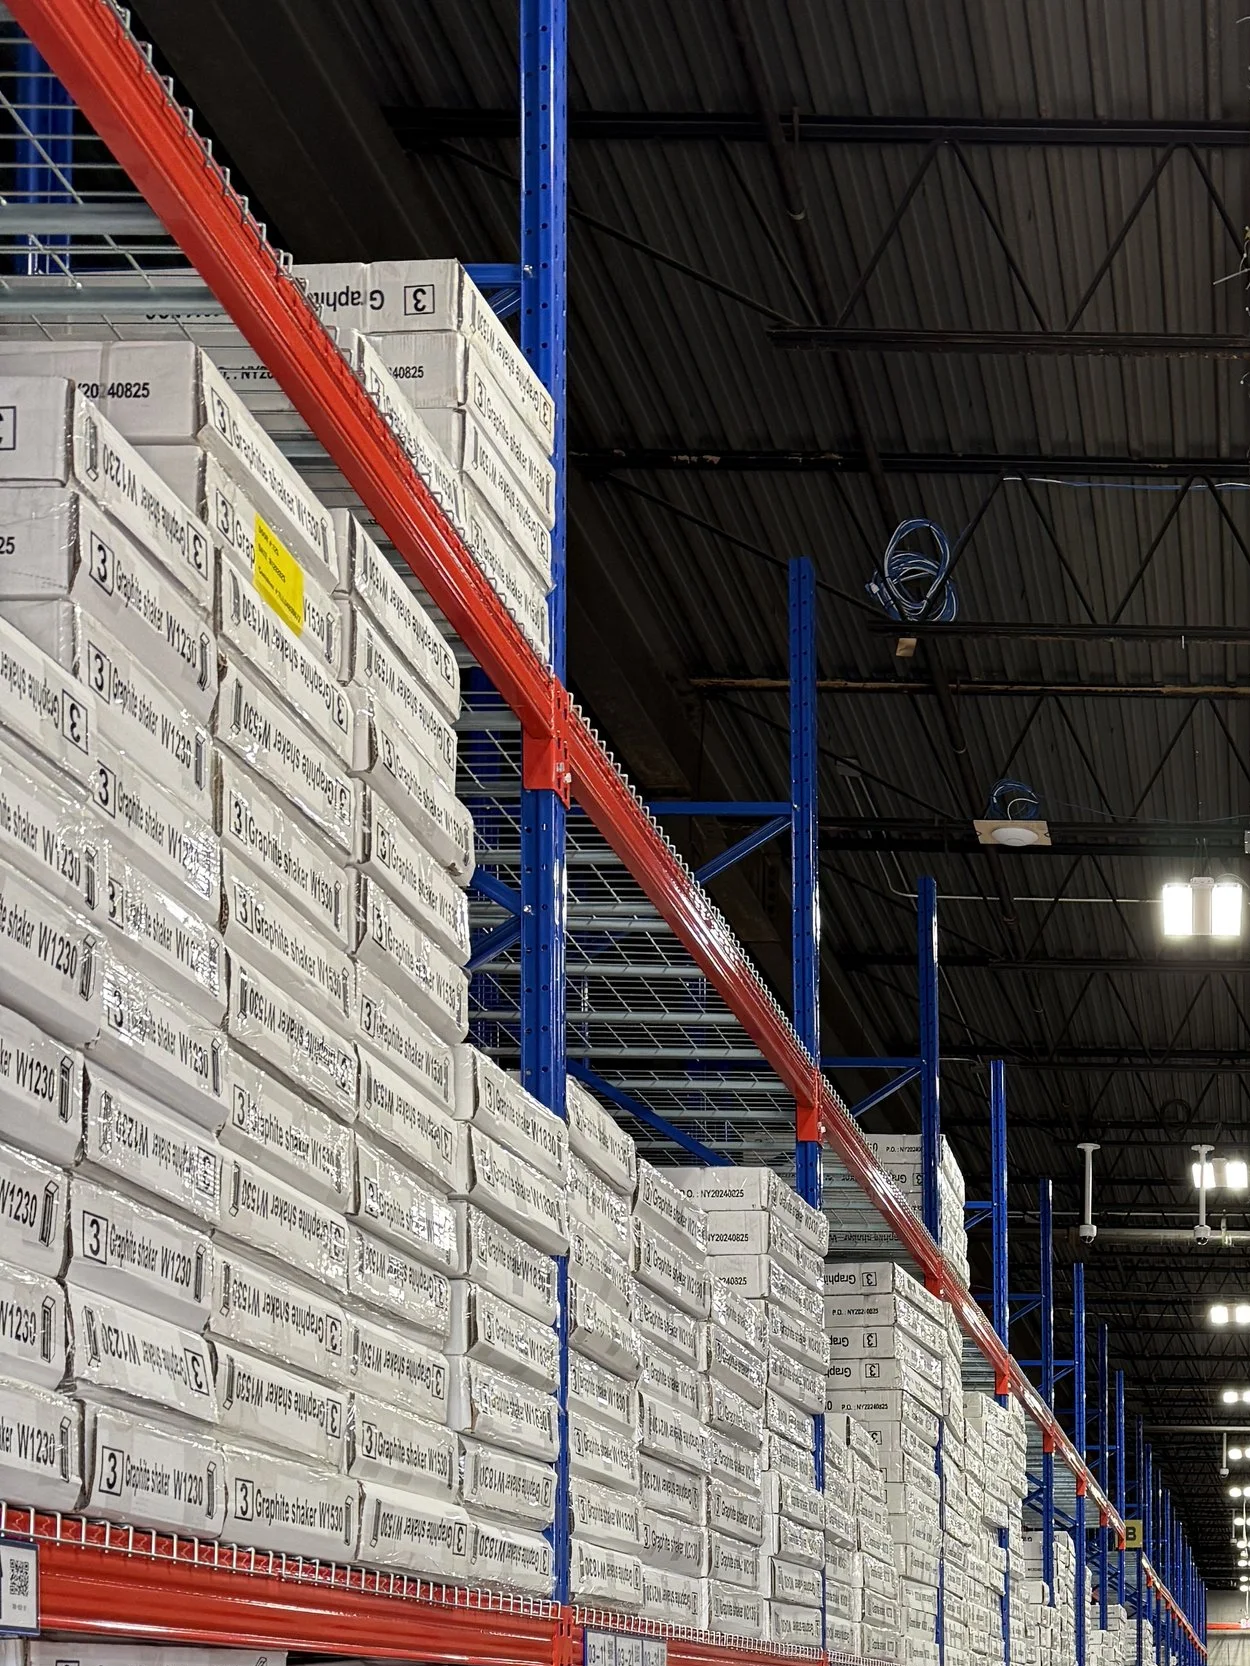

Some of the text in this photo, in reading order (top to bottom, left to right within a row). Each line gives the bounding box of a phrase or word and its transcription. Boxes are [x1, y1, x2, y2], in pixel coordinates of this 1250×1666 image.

[412, 288, 426, 311] 3
[97, 541, 197, 669] 3 Graphite shaker W1230
[243, 594, 271, 648] W1530
[271, 632, 299, 675] shaker
[300, 656, 332, 710] Graphite
[336, 694, 346, 725] 3
[94, 653, 192, 769] 3 Graphite shaker W1230
[238, 892, 341, 1001] 3 Graphite shaker W1530
[89, 1219, 192, 1288] 3 Graphite shaker W1230
[364, 1426, 448, 1478] 3 Graphite shaker W1530
[106, 1452, 203, 1507] 3 Graphite shaker W1230
[239, 1483, 343, 1533] 3 Graphite shaker W1530
